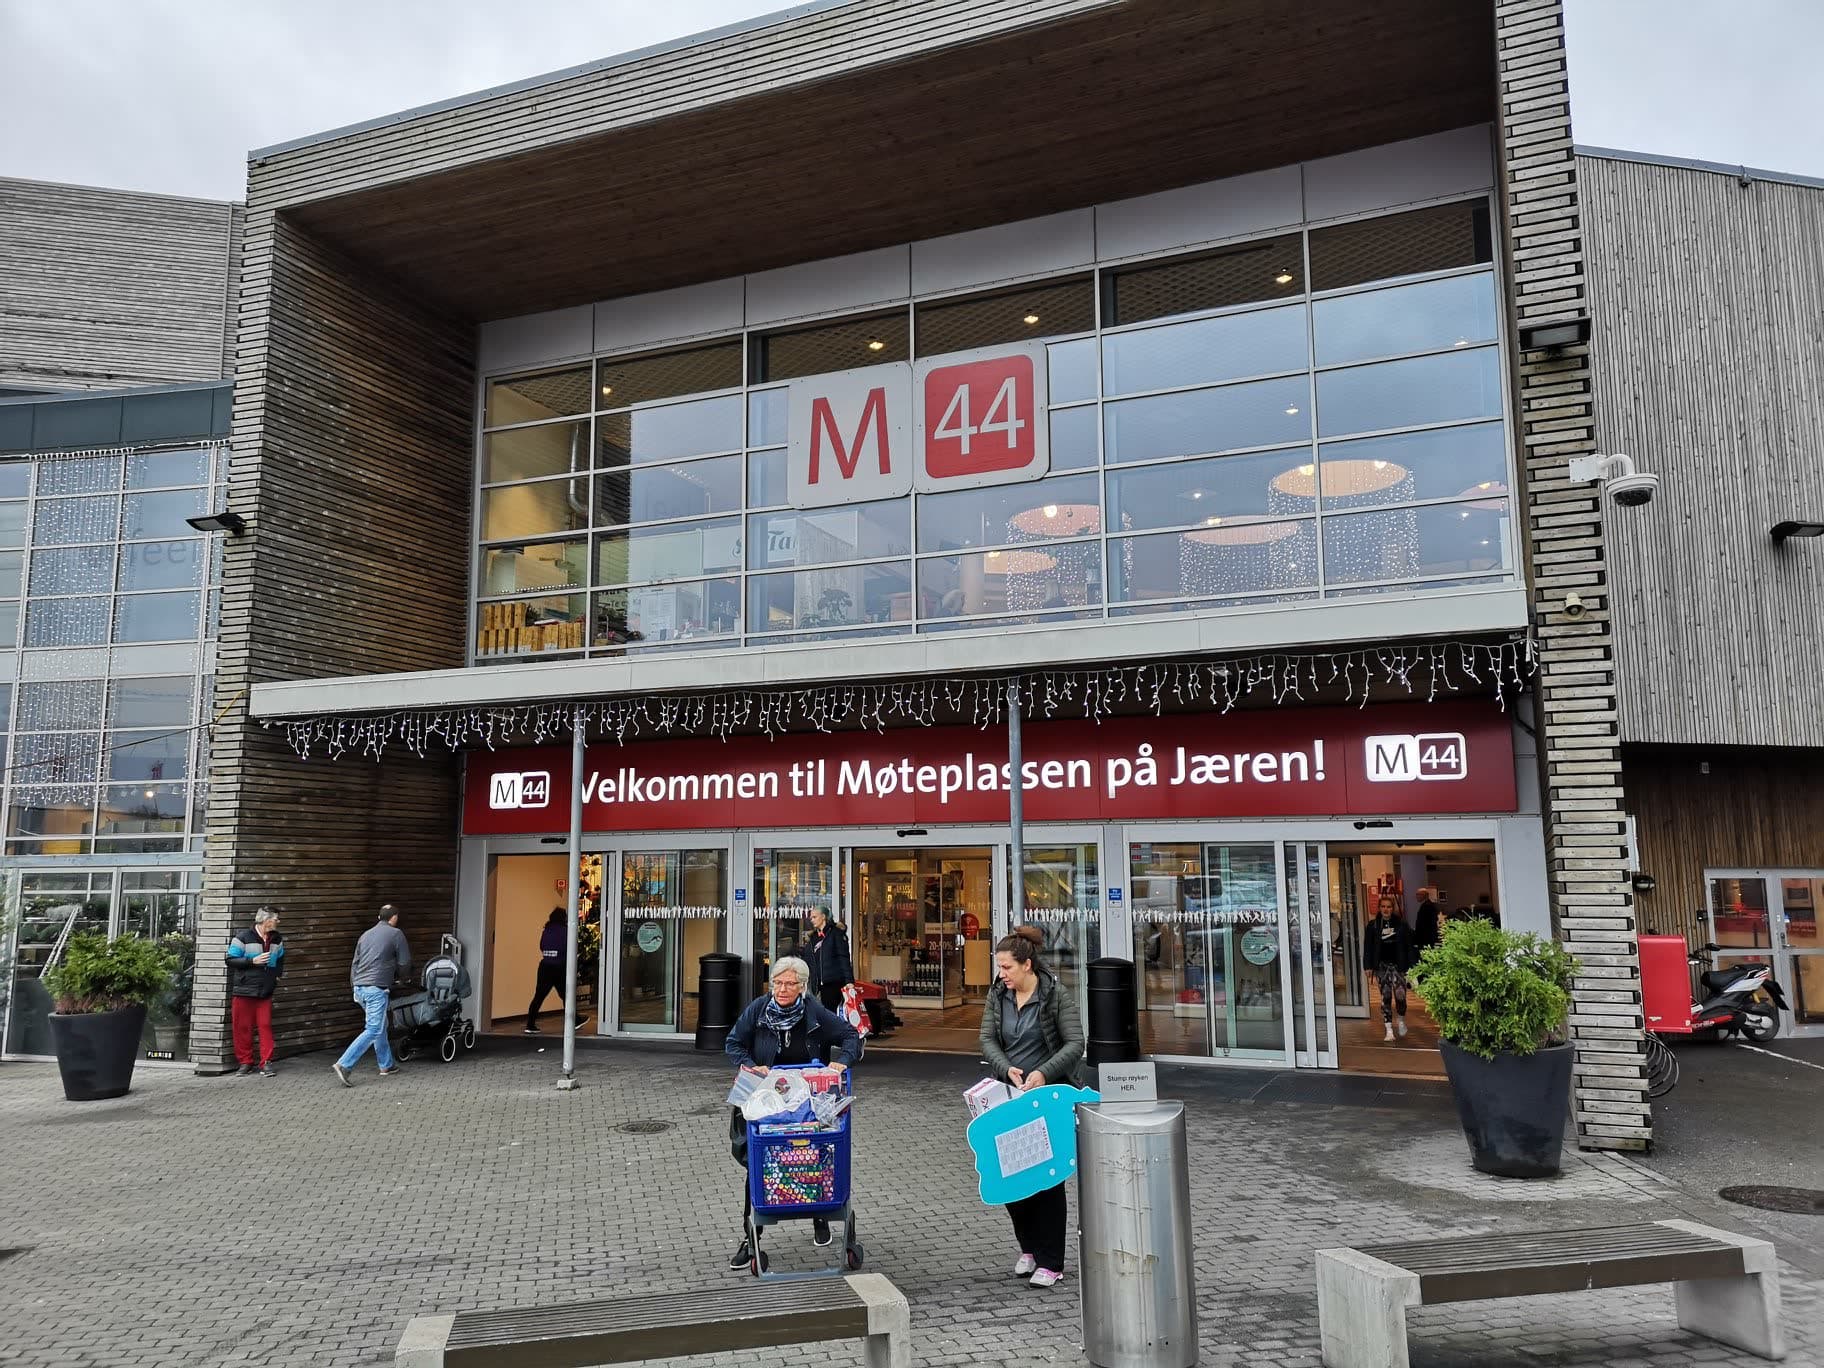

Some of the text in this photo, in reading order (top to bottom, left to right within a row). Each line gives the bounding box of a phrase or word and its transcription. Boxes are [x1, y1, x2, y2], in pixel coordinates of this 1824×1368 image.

[808, 376, 1025, 485] M 44
[580, 739, 1327, 804] Velkommen til Møteplassen på Jæren!
[1375, 743, 1460, 774] M 44
[495, 779, 545, 803] M 44
